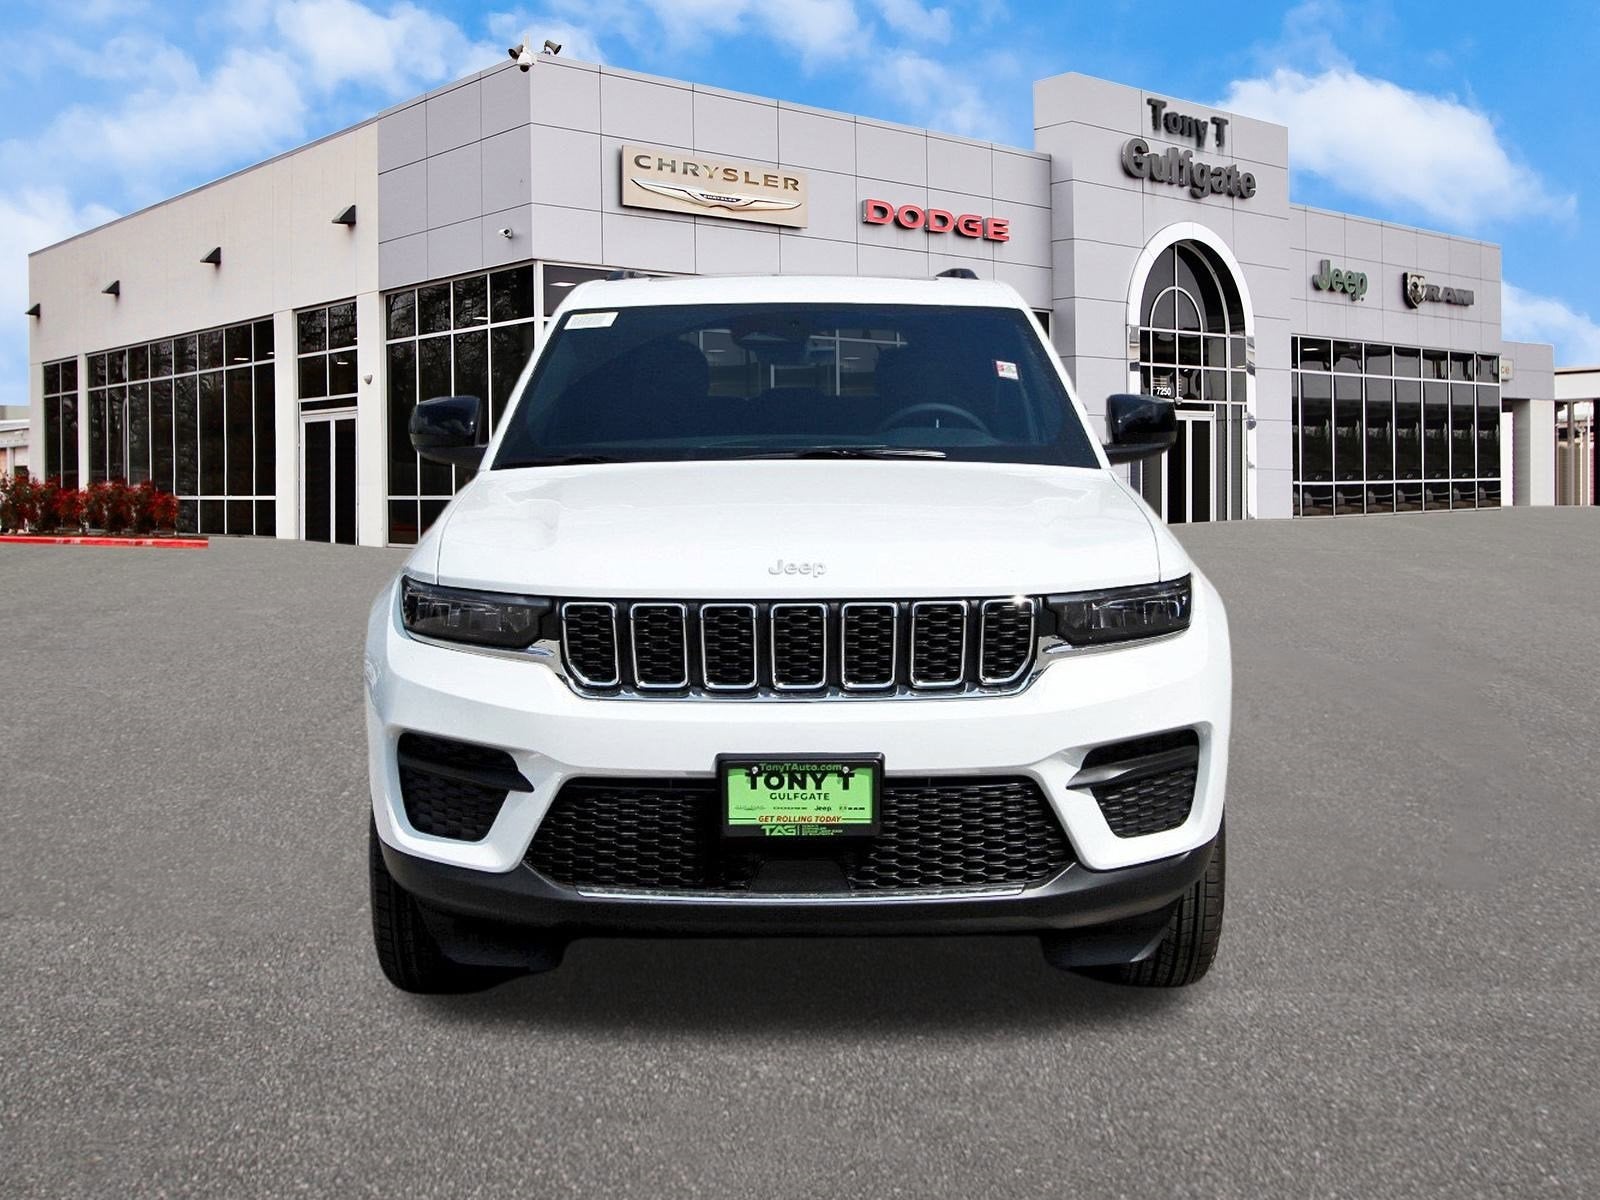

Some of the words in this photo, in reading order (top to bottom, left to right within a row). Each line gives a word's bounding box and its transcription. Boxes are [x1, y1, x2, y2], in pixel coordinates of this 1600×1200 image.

[1147, 98, 1208, 148] Tony
[1210, 116, 1229, 147] T
[633, 154, 800, 191] CHRYSLER
[1121, 138, 1256, 199] Gulfgate
[863, 199, 1010, 242] DODGE
[1312, 259, 1368, 301] Jeep
[1424, 284, 1474, 306] RAM
[1156, 387, 1172, 396] 7250
[768, 559, 827, 578] Jeep
[760, 763, 842, 773] TonyTAuto.com
[745, 771, 827, 790] TONY
[836, 771, 855, 790] T
[769, 792, 830, 801] GULFGATE
[758, 815, 775, 823] GET
[776, 815, 813, 823] ROLLING
[815, 815, 842, 823] TODAY
